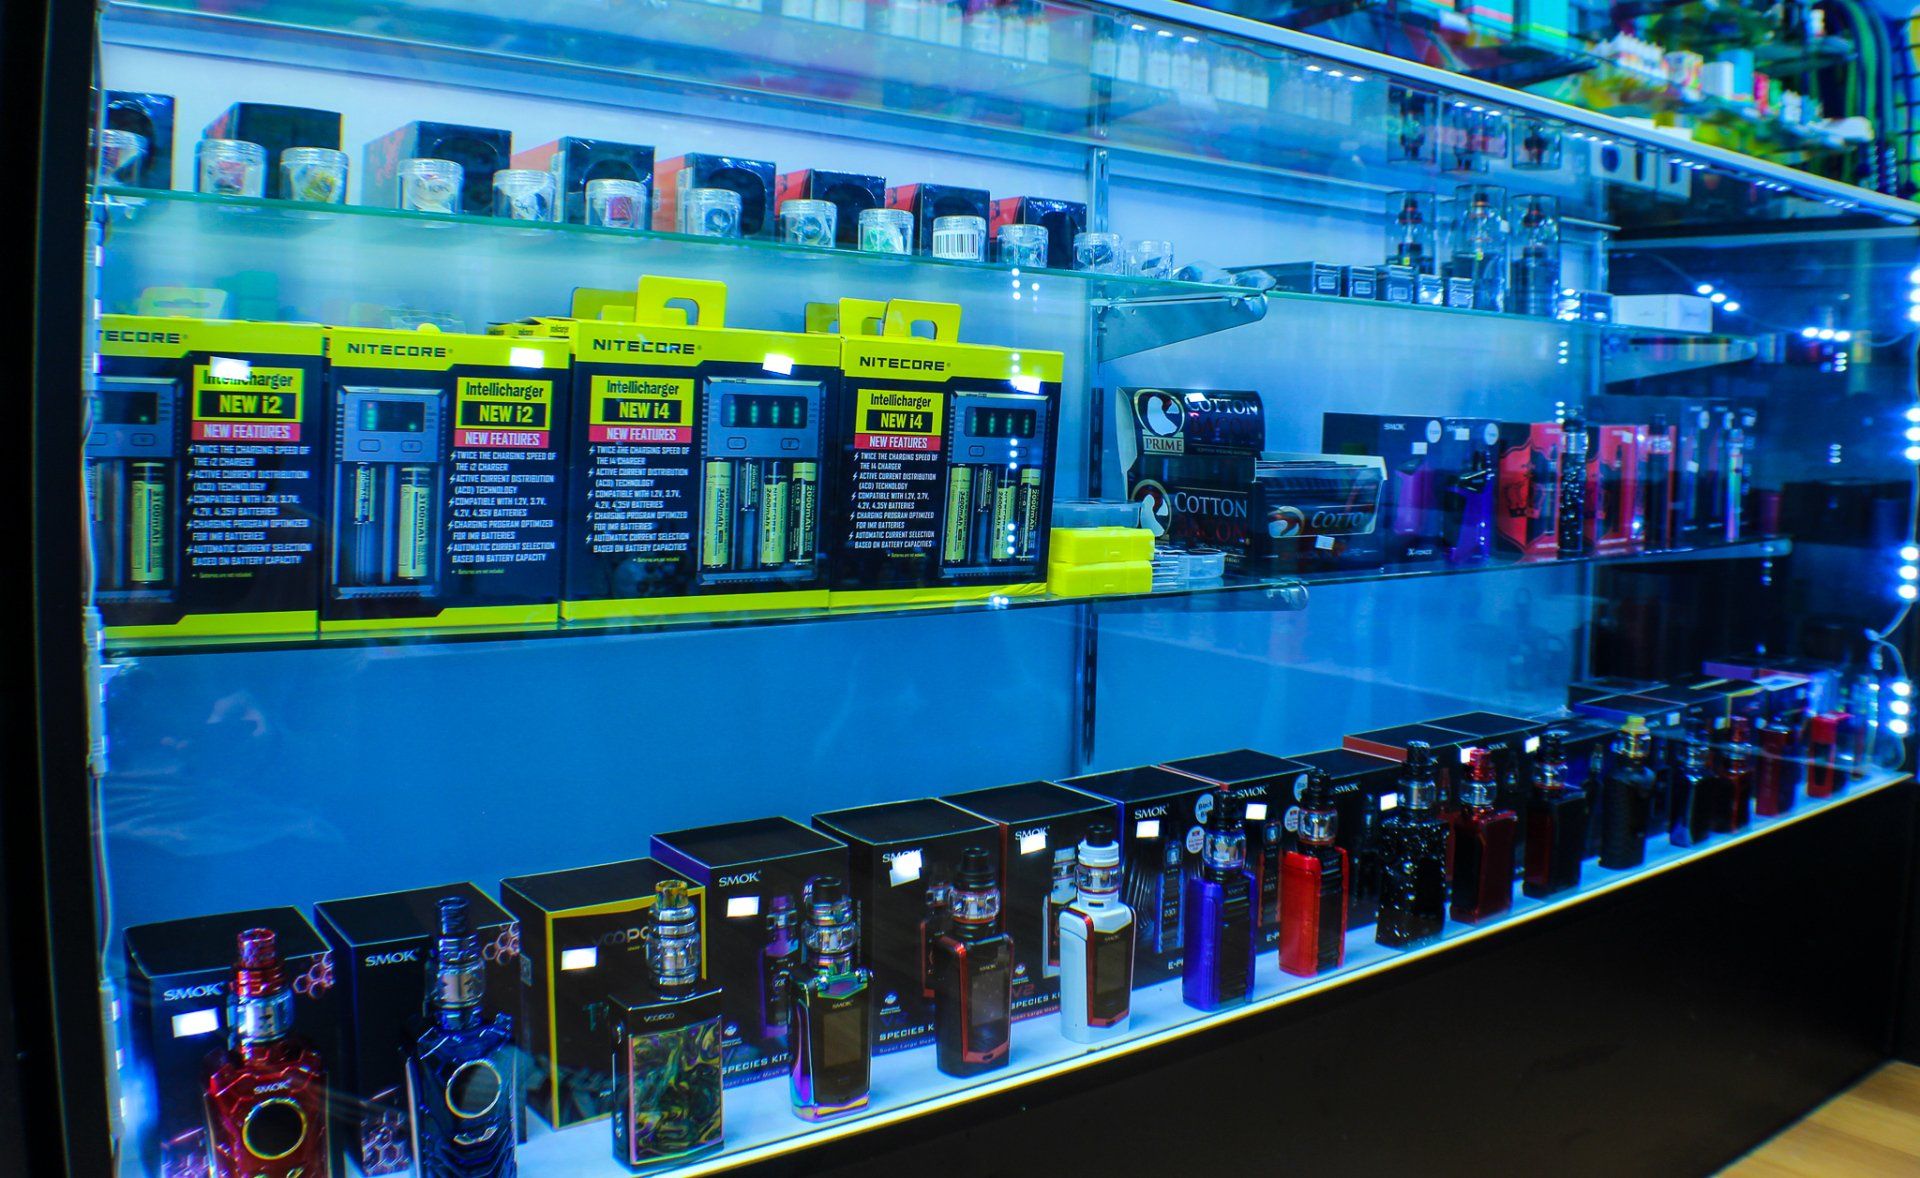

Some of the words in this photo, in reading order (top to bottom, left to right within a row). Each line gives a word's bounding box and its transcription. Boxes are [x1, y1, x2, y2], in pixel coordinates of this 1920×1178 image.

[348, 343, 446, 357] NITECORE
[593, 339, 694, 354] NITECORE
[860, 356, 944, 370] NITECORE
[466, 382, 544, 400] Intellicharger
[607, 380, 679, 398] Intellicharger
[219, 394, 258, 413] NEW
[262, 395, 282, 414] i2
[871, 393, 931, 410] Intellicharger
[480, 405, 512, 422] NEW
[517, 406, 533, 423] i2
[619, 402, 651, 418] NEW
[654, 402, 670, 418] i4
[881, 412, 907, 429] NEW
[910, 413, 922, 429] i4
[203, 424, 231, 438] NEW
[232, 424, 290, 439] FEATURES
[465, 432, 489, 445] NEW
[490, 432, 540, 446] FEATURES
[607, 427, 629, 440] NEW
[630, 428, 677, 441] FEATURES
[870, 436, 888, 448] NEW
[889, 436, 928, 448] FEATURES
[1145, 437, 1183, 451] PRIME
[805, 485, 813, 531] 2000mAh
[1029, 489, 1038, 531] 2000mAh
[1175, 492, 1247, 518] COTTON
[418, 493, 426, 542] 3100mAh
[1237, 785, 1267, 798] SMOK
[1135, 806, 1168, 819] SMOK
[719, 872, 760, 887] SMOK
[365, 950, 417, 967] SMOK
[164, 985, 223, 1001] SMOK
[771, 1052, 789, 1063] KIT
[254, 1081, 290, 1094] SMOK
